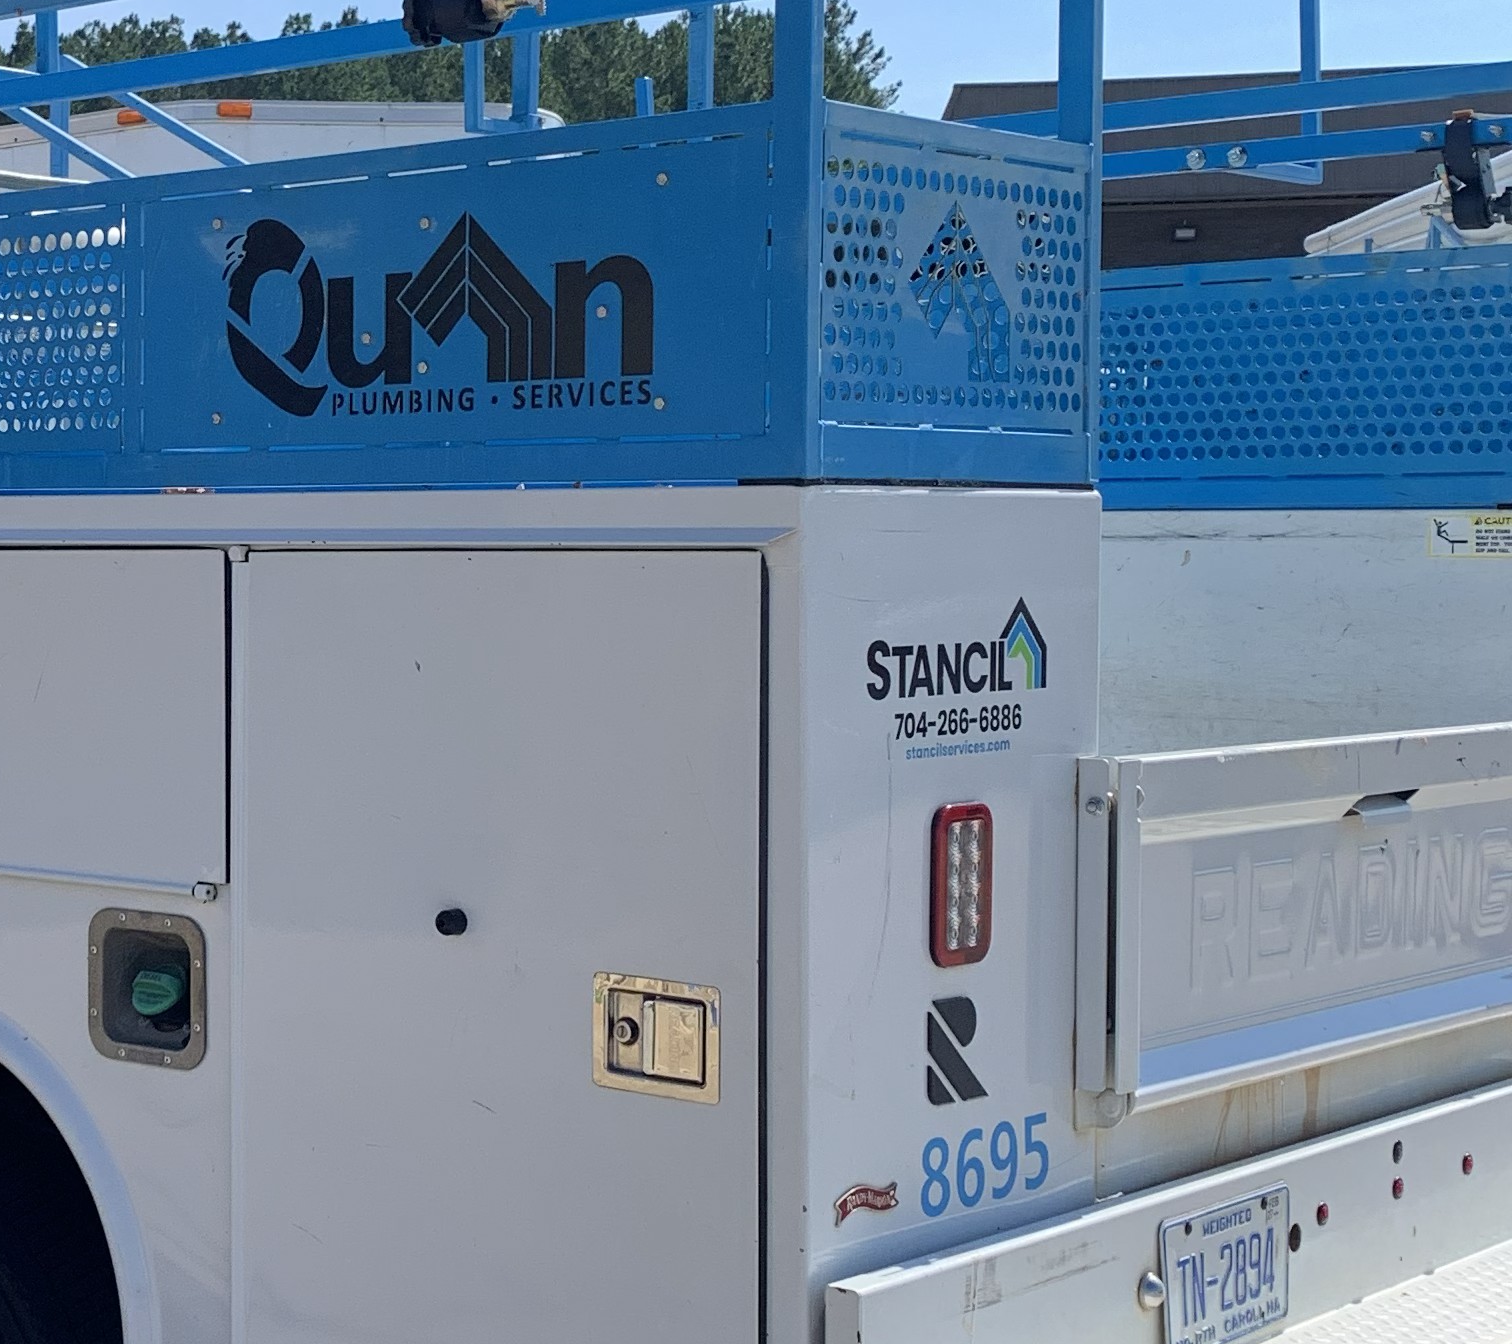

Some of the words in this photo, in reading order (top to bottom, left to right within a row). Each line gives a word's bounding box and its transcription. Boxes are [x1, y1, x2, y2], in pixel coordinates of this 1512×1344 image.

[331, 386, 476, 417] PLUMBING
[511, 380, 653, 410] SERVICES
[866, 639, 1012, 701] STANCIL
[894, 703, 1022, 740] 704-266-6886
[905, 737, 1011, 761] stancilservices.com
[1187, 827, 1512, 993] READING
[919, 1111, 1050, 1218] 8695
[1203, 1208, 1251, 1237] WEIGHTED
[1177, 1227, 1275, 1327] TN-2894
[1224, 1299, 1281, 1333] CAROLINA
